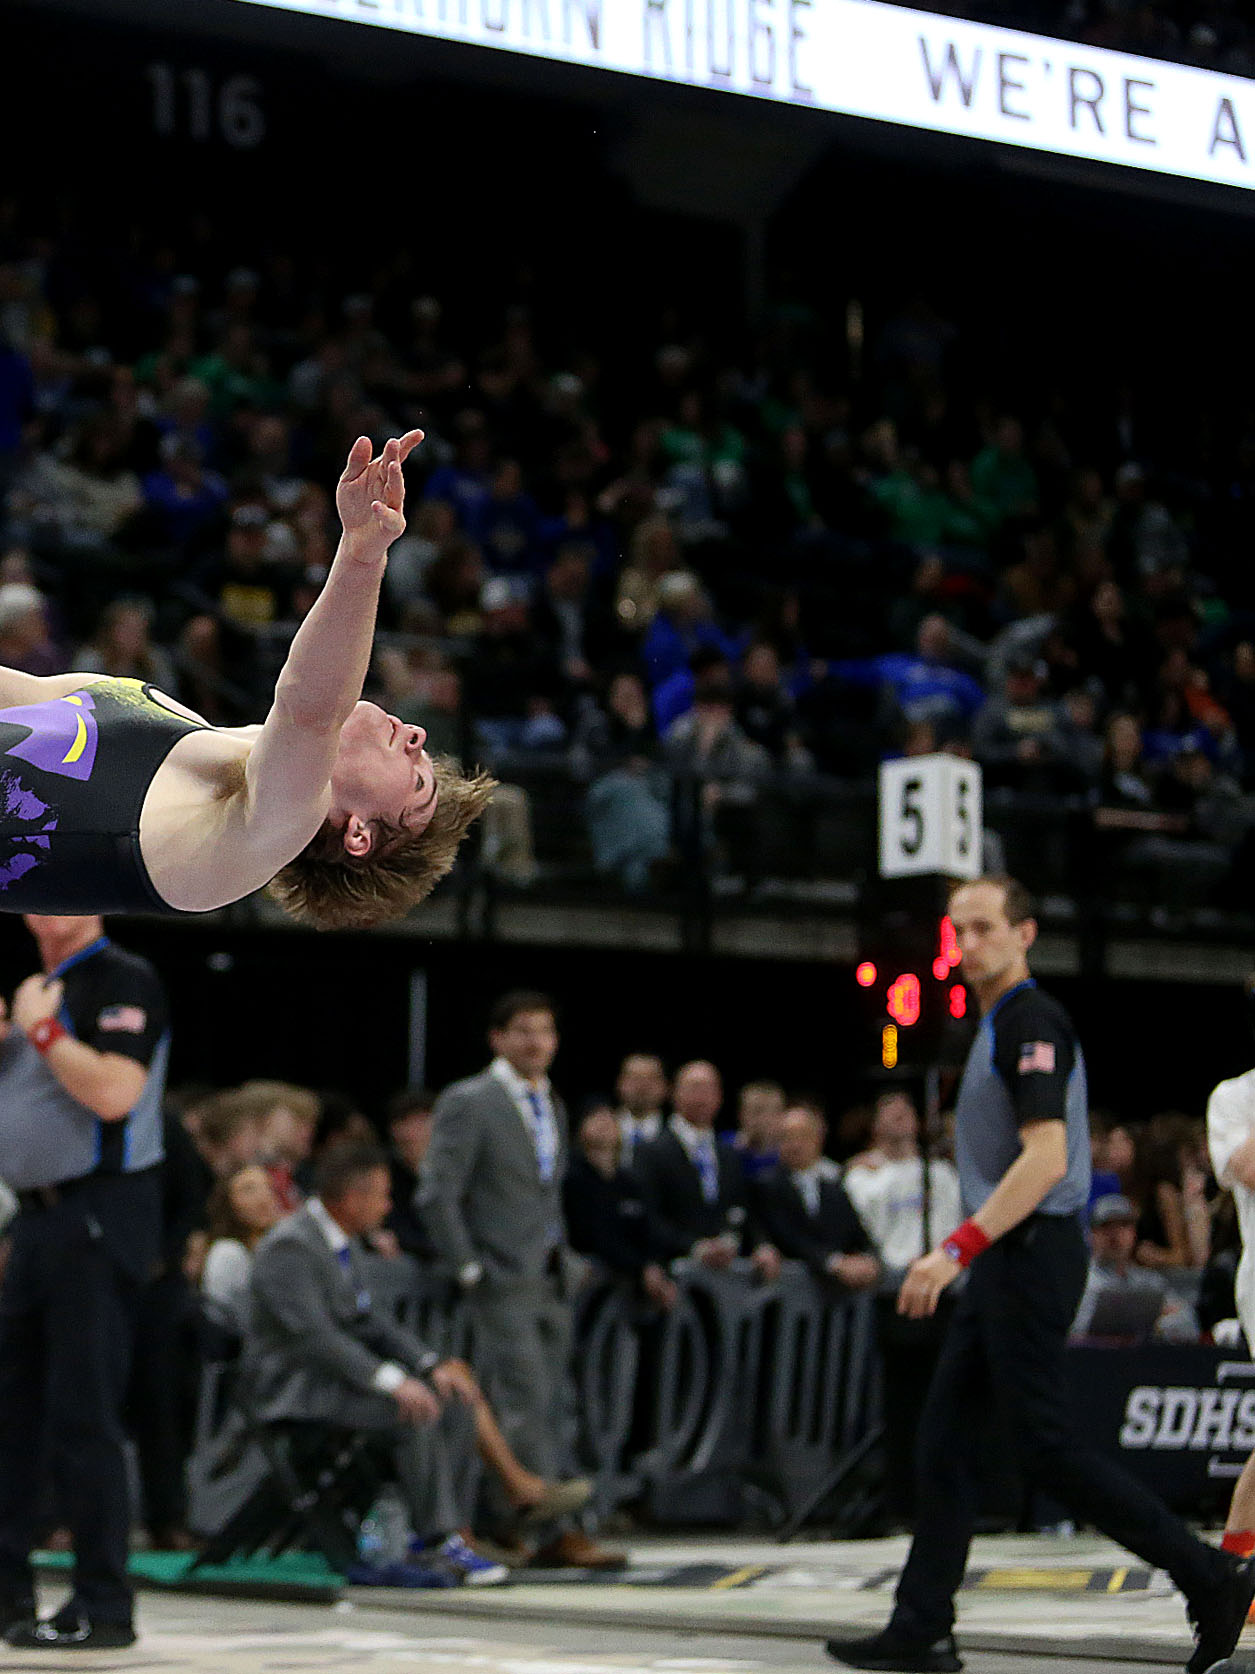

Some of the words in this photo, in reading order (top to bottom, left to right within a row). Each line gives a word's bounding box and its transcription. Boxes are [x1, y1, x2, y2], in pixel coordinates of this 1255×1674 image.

[146, 62, 266, 148] 116
[917, 35, 1159, 144] WE'RE
[901, 777, 924, 857] 5
[1120, 1386, 1255, 1450] SDHS
